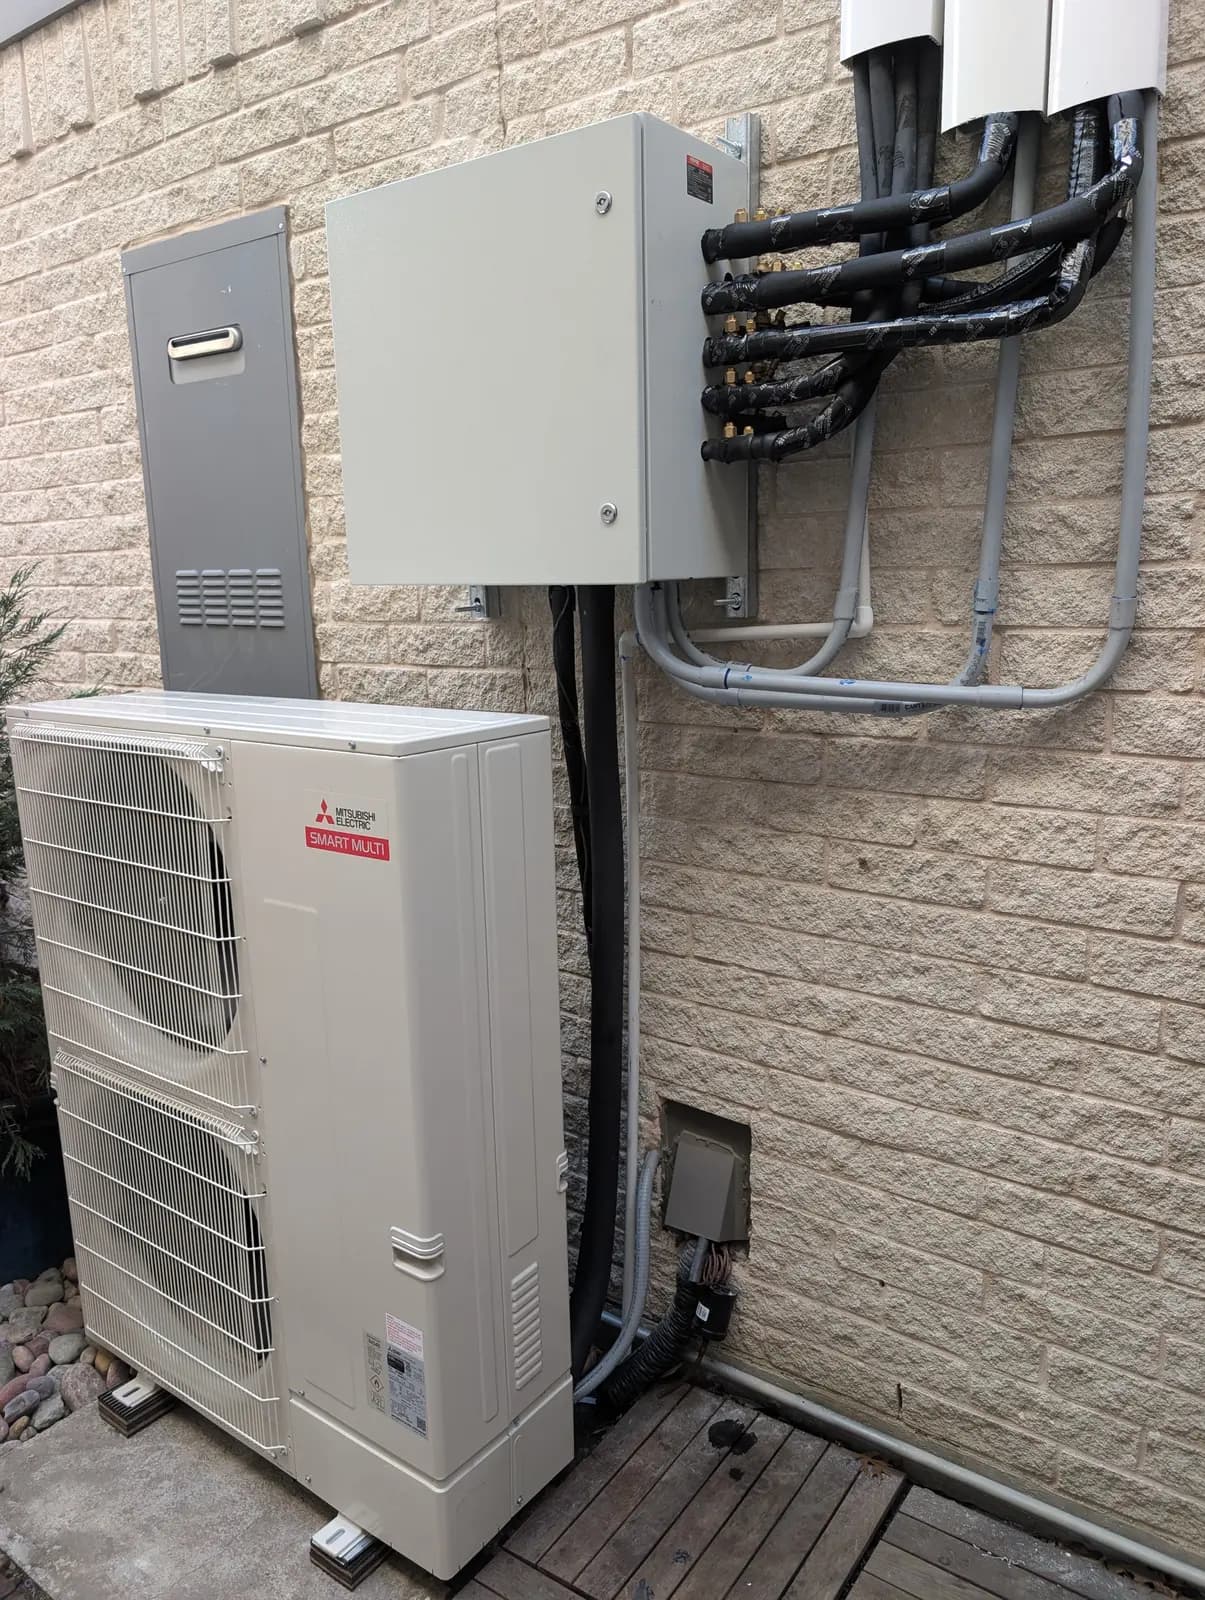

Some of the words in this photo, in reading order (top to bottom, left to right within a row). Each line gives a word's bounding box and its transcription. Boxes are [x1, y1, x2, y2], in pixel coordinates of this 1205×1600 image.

[335, 807, 376, 821] MITSUBISHI
[336, 817, 371, 830] ELECTRIC
[310, 831, 350, 849] SMART
[351, 838, 385, 856] MULTI
